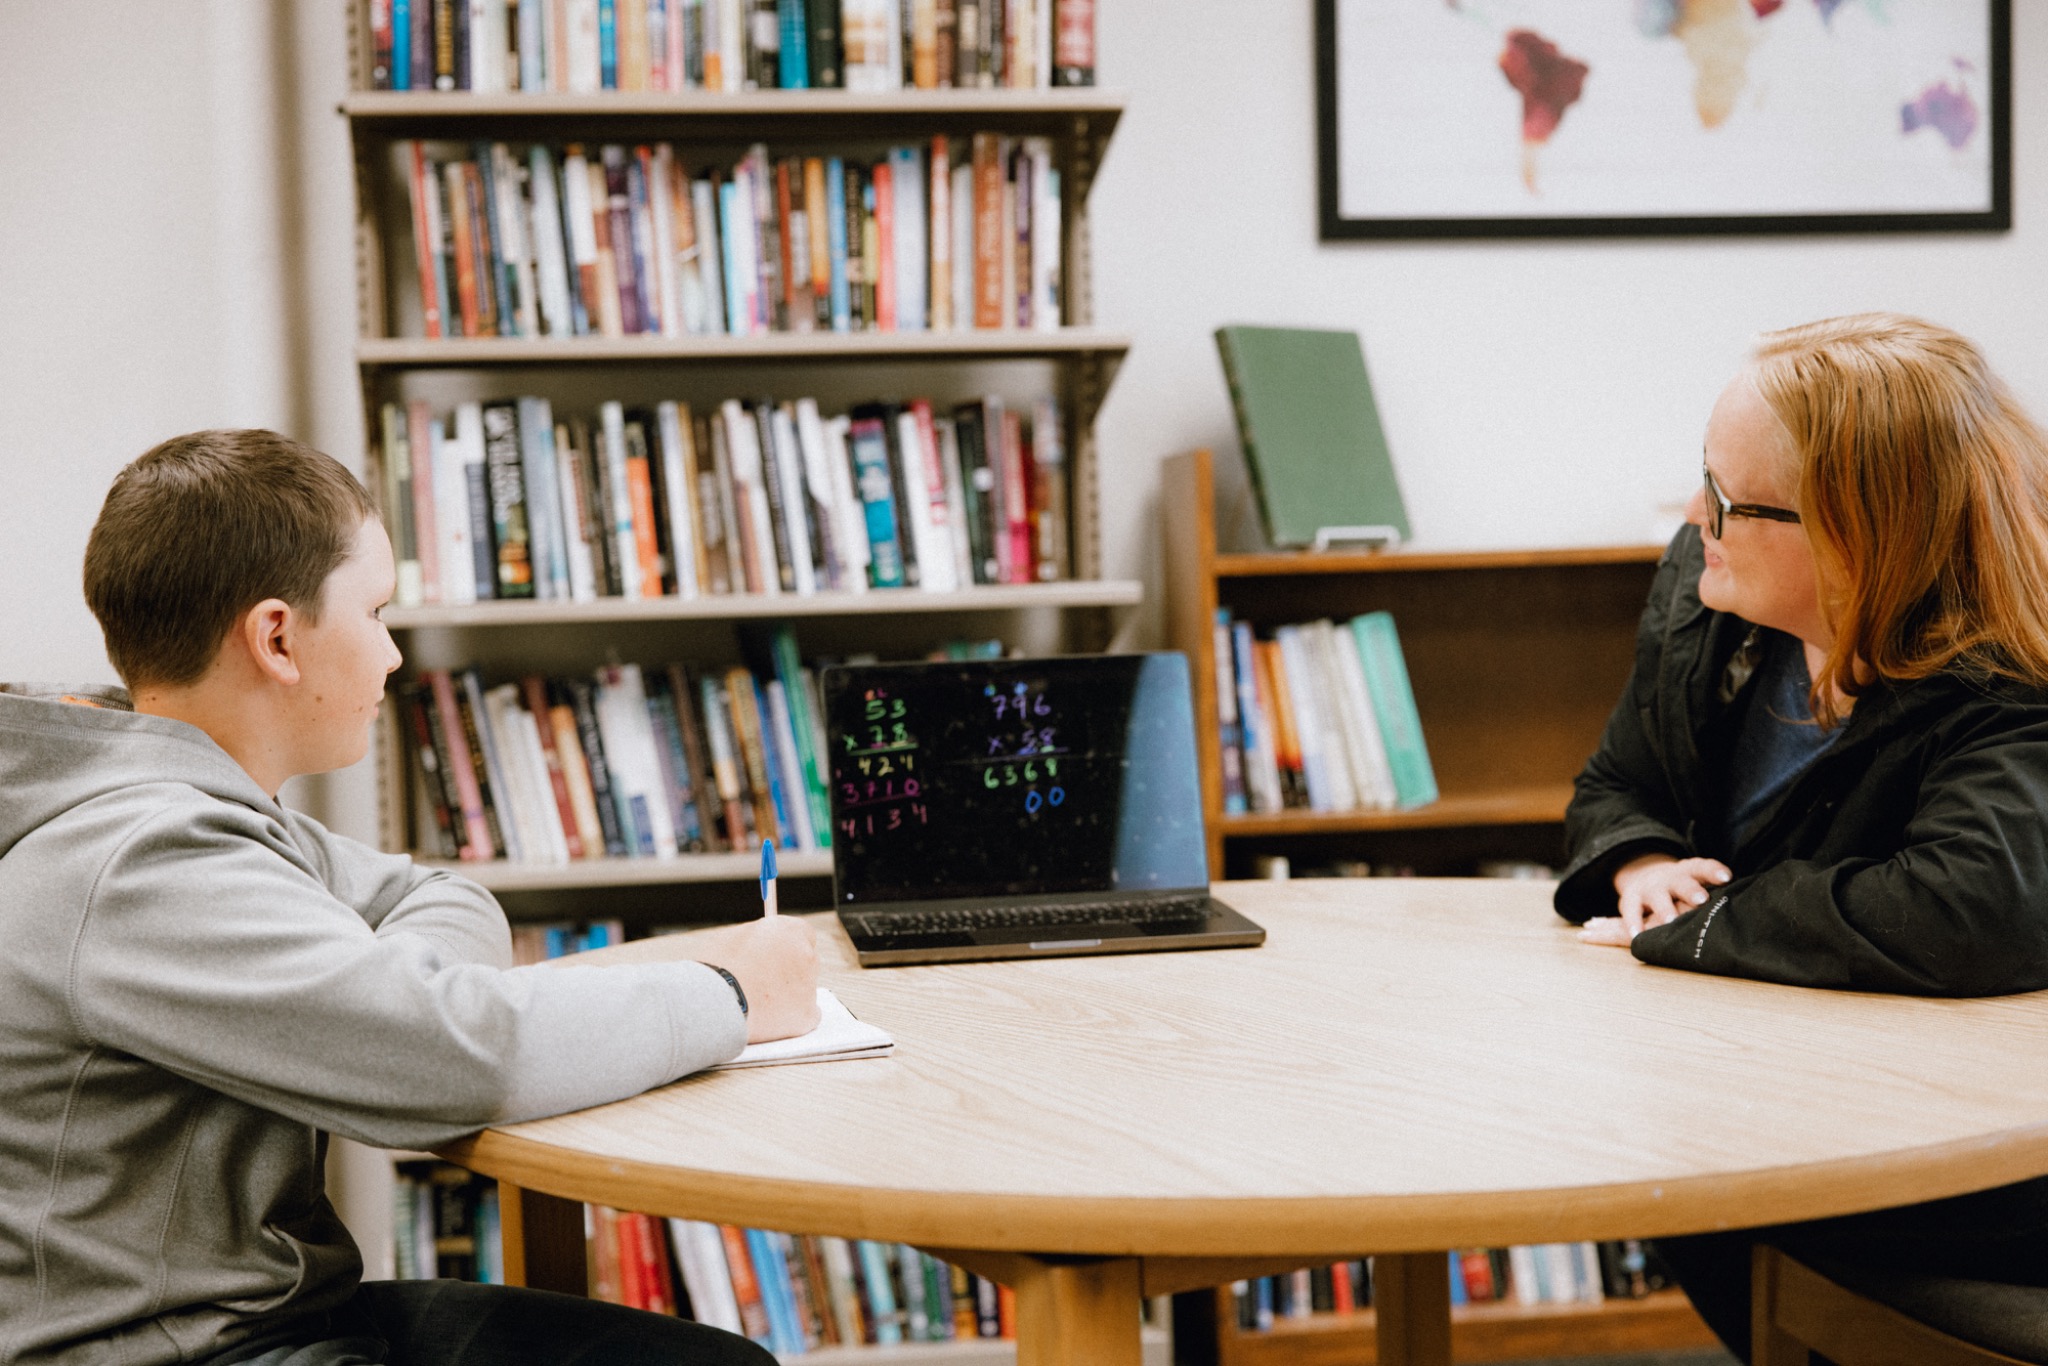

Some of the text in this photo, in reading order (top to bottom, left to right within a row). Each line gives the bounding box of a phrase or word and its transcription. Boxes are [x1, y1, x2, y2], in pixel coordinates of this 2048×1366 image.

[865, 699, 907, 721] 53
[991, 694, 1052, 720] 796
[858, 754, 914, 777] 424
[983, 757, 1058, 789] 6368
[842, 777, 920, 803] 3710
[1025, 786, 1065, 814] 00
[841, 802, 928, 840] 4134
